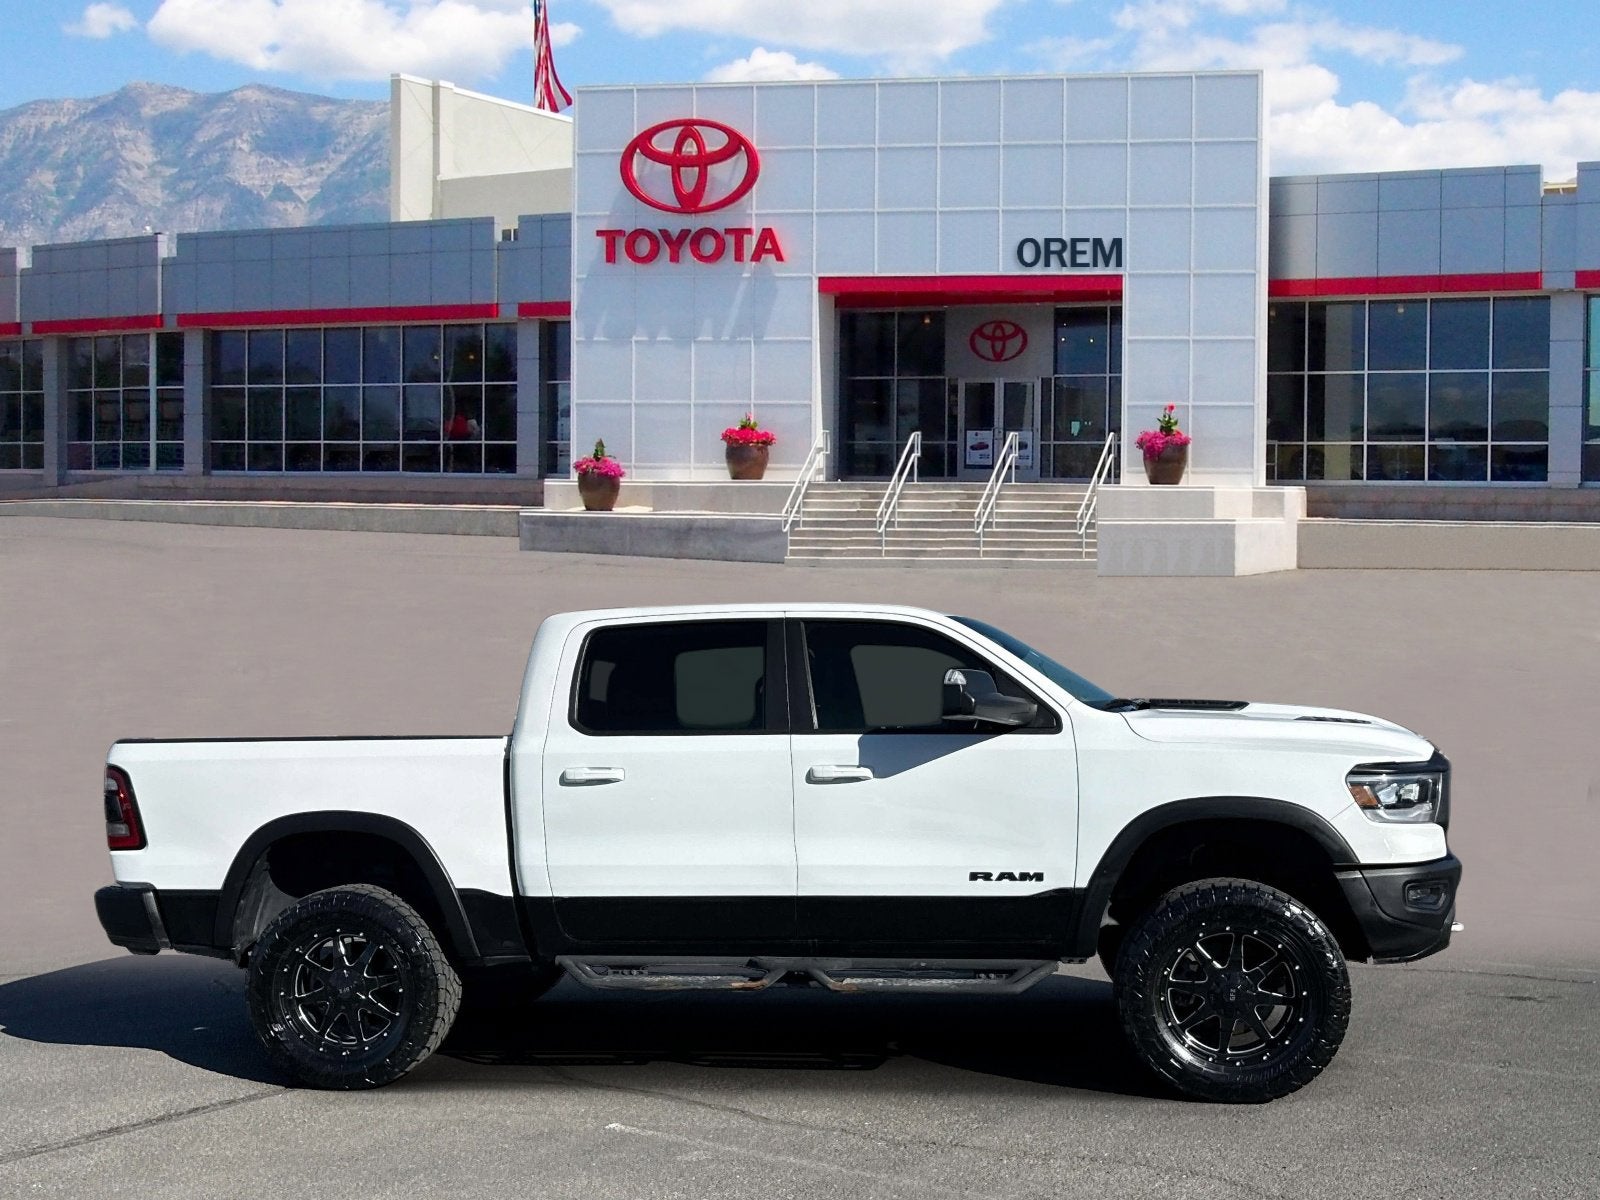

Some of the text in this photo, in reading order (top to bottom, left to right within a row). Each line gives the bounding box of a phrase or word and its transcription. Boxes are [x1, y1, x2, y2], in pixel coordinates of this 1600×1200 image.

[596, 227, 784, 264] TOYOTA
[1017, 237, 1123, 268] OREM
[968, 871, 1044, 882] RAM
